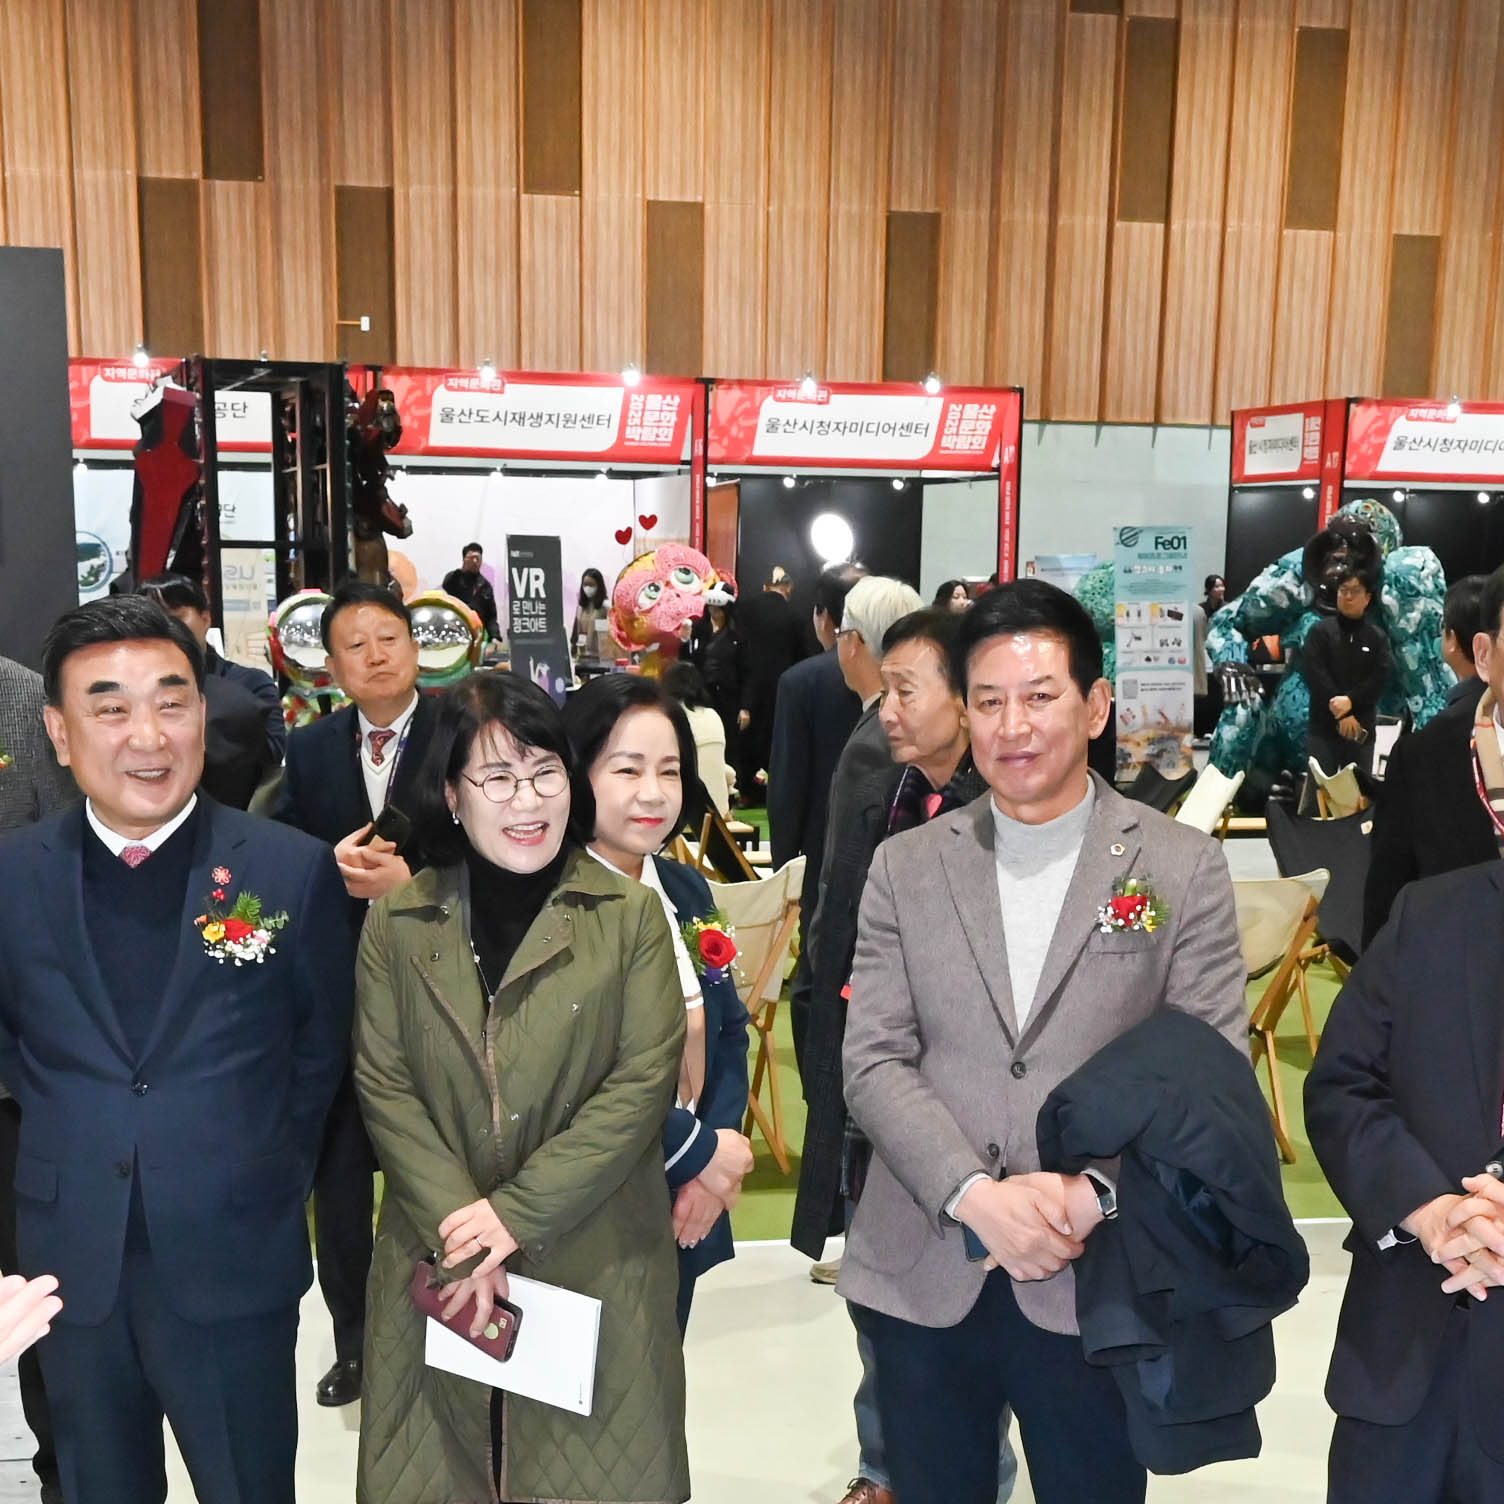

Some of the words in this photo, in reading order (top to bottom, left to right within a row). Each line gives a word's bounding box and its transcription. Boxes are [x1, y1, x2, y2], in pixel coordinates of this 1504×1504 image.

[439, 406, 613, 430] 울산도시재생지원센터
[765, 417, 930, 438] 울산시청자미디어센터
[1154, 535, 1188, 551] Fe01
[511, 567, 546, 599] VR
[522, 601, 546, 615] 만나는
